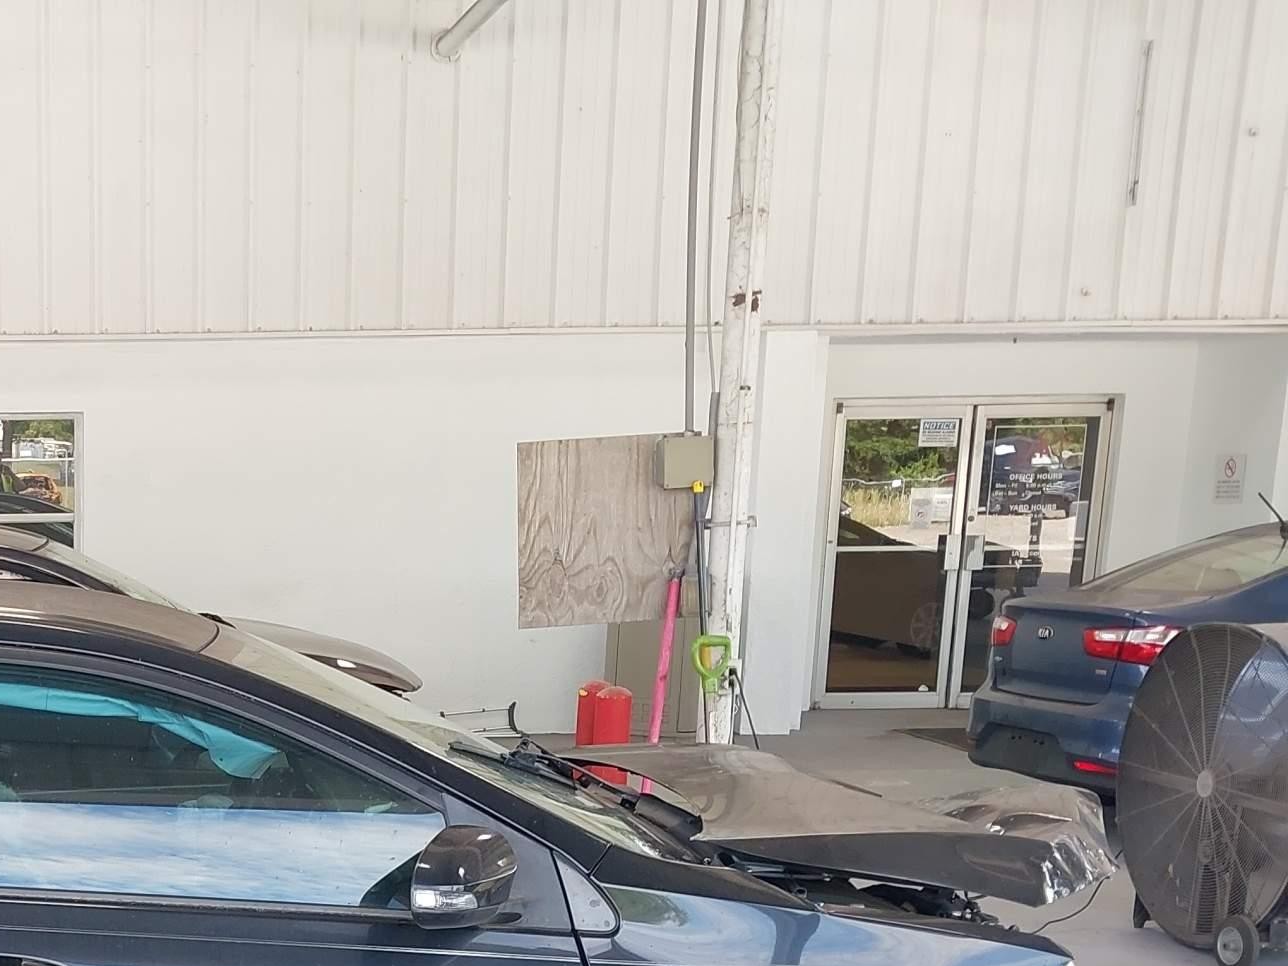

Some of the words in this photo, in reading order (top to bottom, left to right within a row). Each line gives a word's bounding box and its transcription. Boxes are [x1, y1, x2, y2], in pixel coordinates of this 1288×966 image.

[923, 422, 956, 430] NOTICE
[1009, 473, 1035, 481] OFFICE
[1036, 472, 1063, 480] HOURS
[1030, 503, 1057, 511] HOURS
